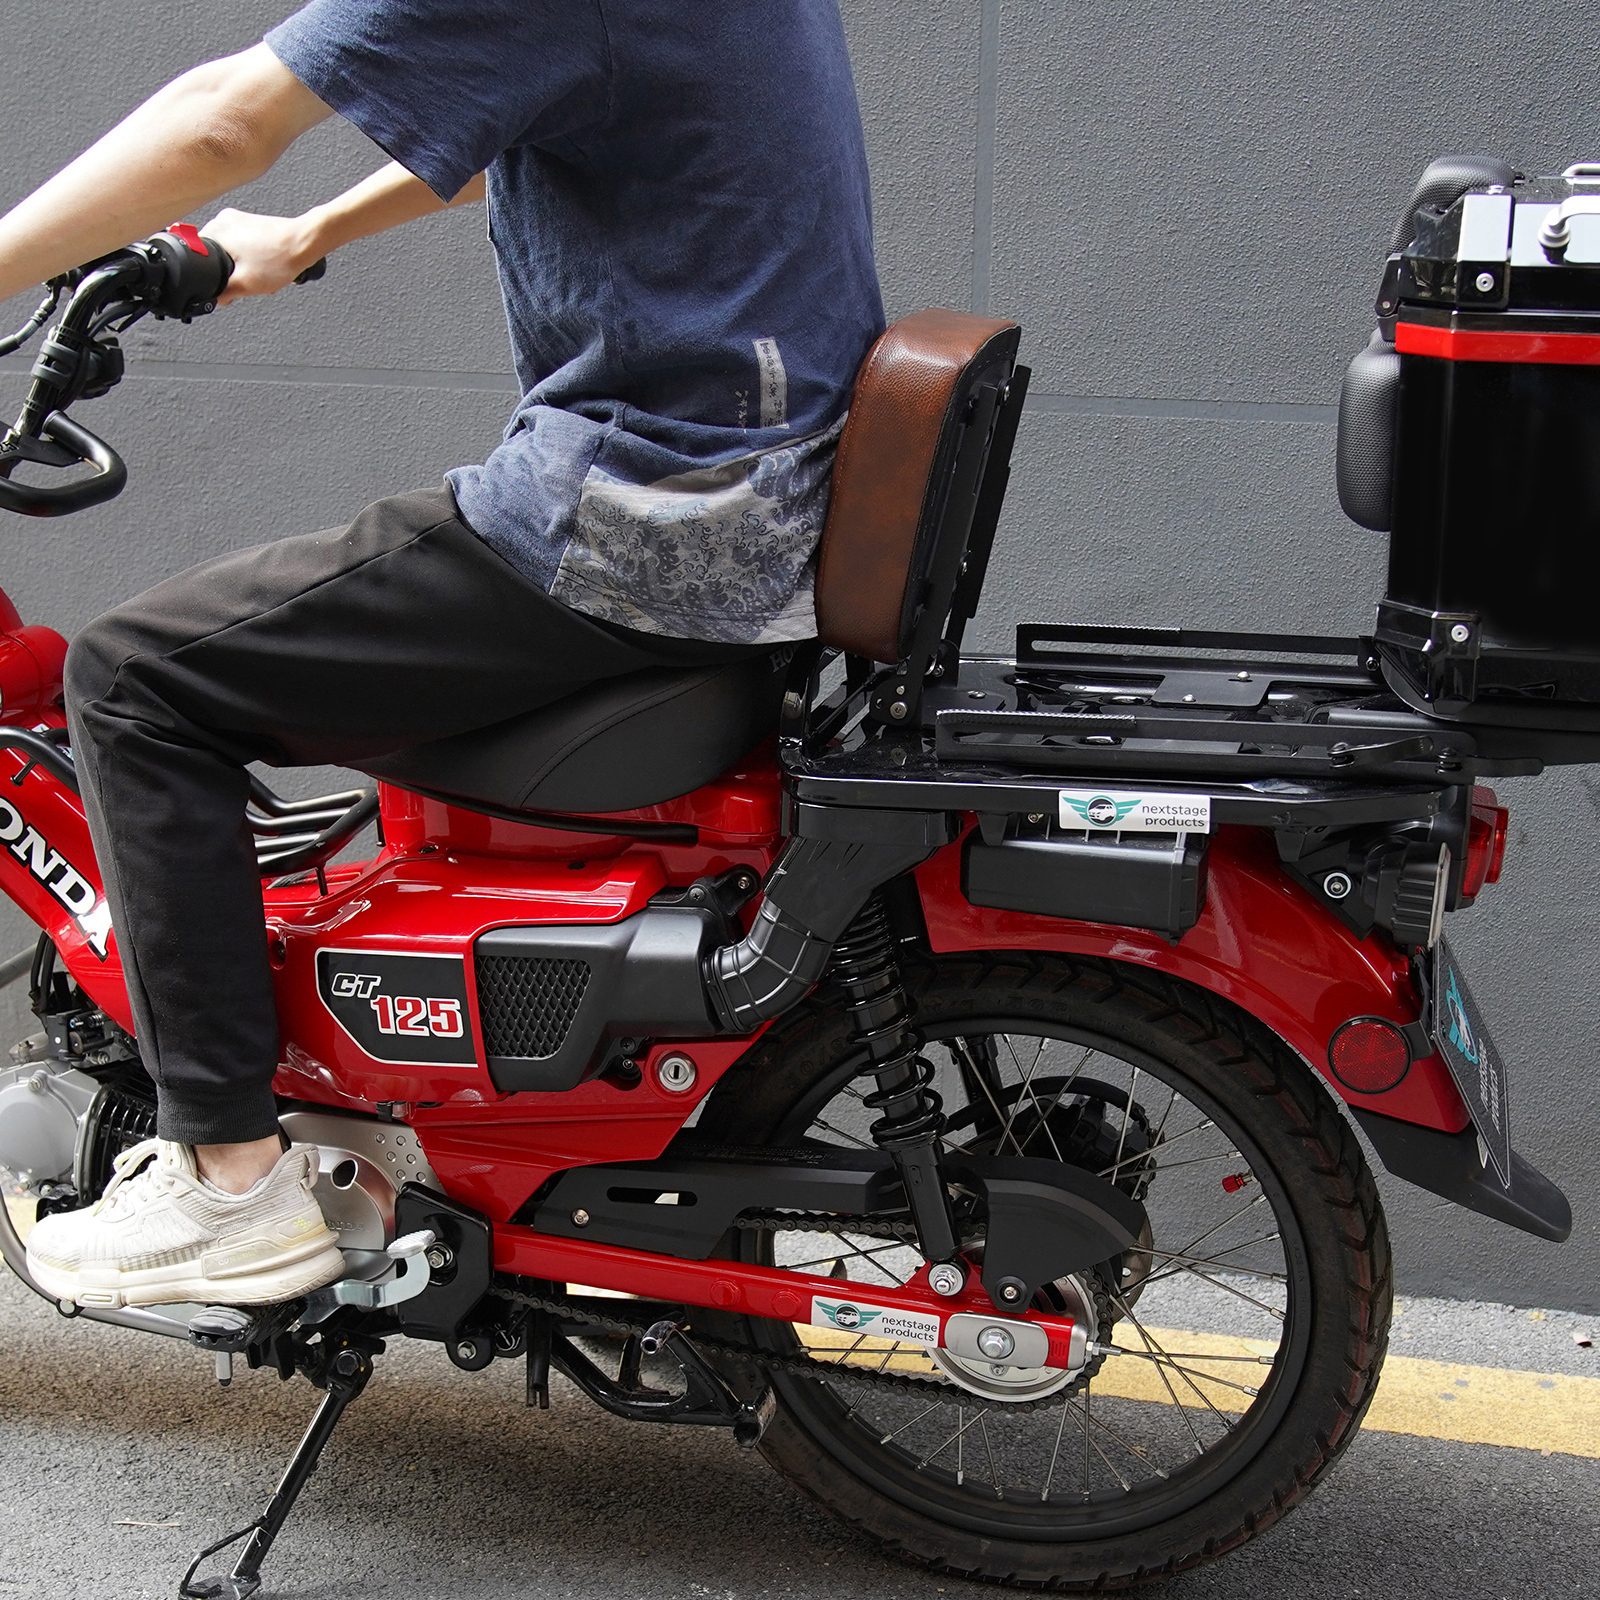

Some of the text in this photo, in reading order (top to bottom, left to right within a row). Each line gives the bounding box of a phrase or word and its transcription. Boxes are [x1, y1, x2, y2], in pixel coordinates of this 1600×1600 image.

[1142, 804, 1208, 816] nextstage
[1145, 816, 1205, 827] products
[0, 797, 112, 956] ONDA
[331, 972, 382, 999] CT
[370, 994, 464, 1038] 125
[882, 1317, 938, 1333] nextstage
[885, 1327, 935, 1341] products
